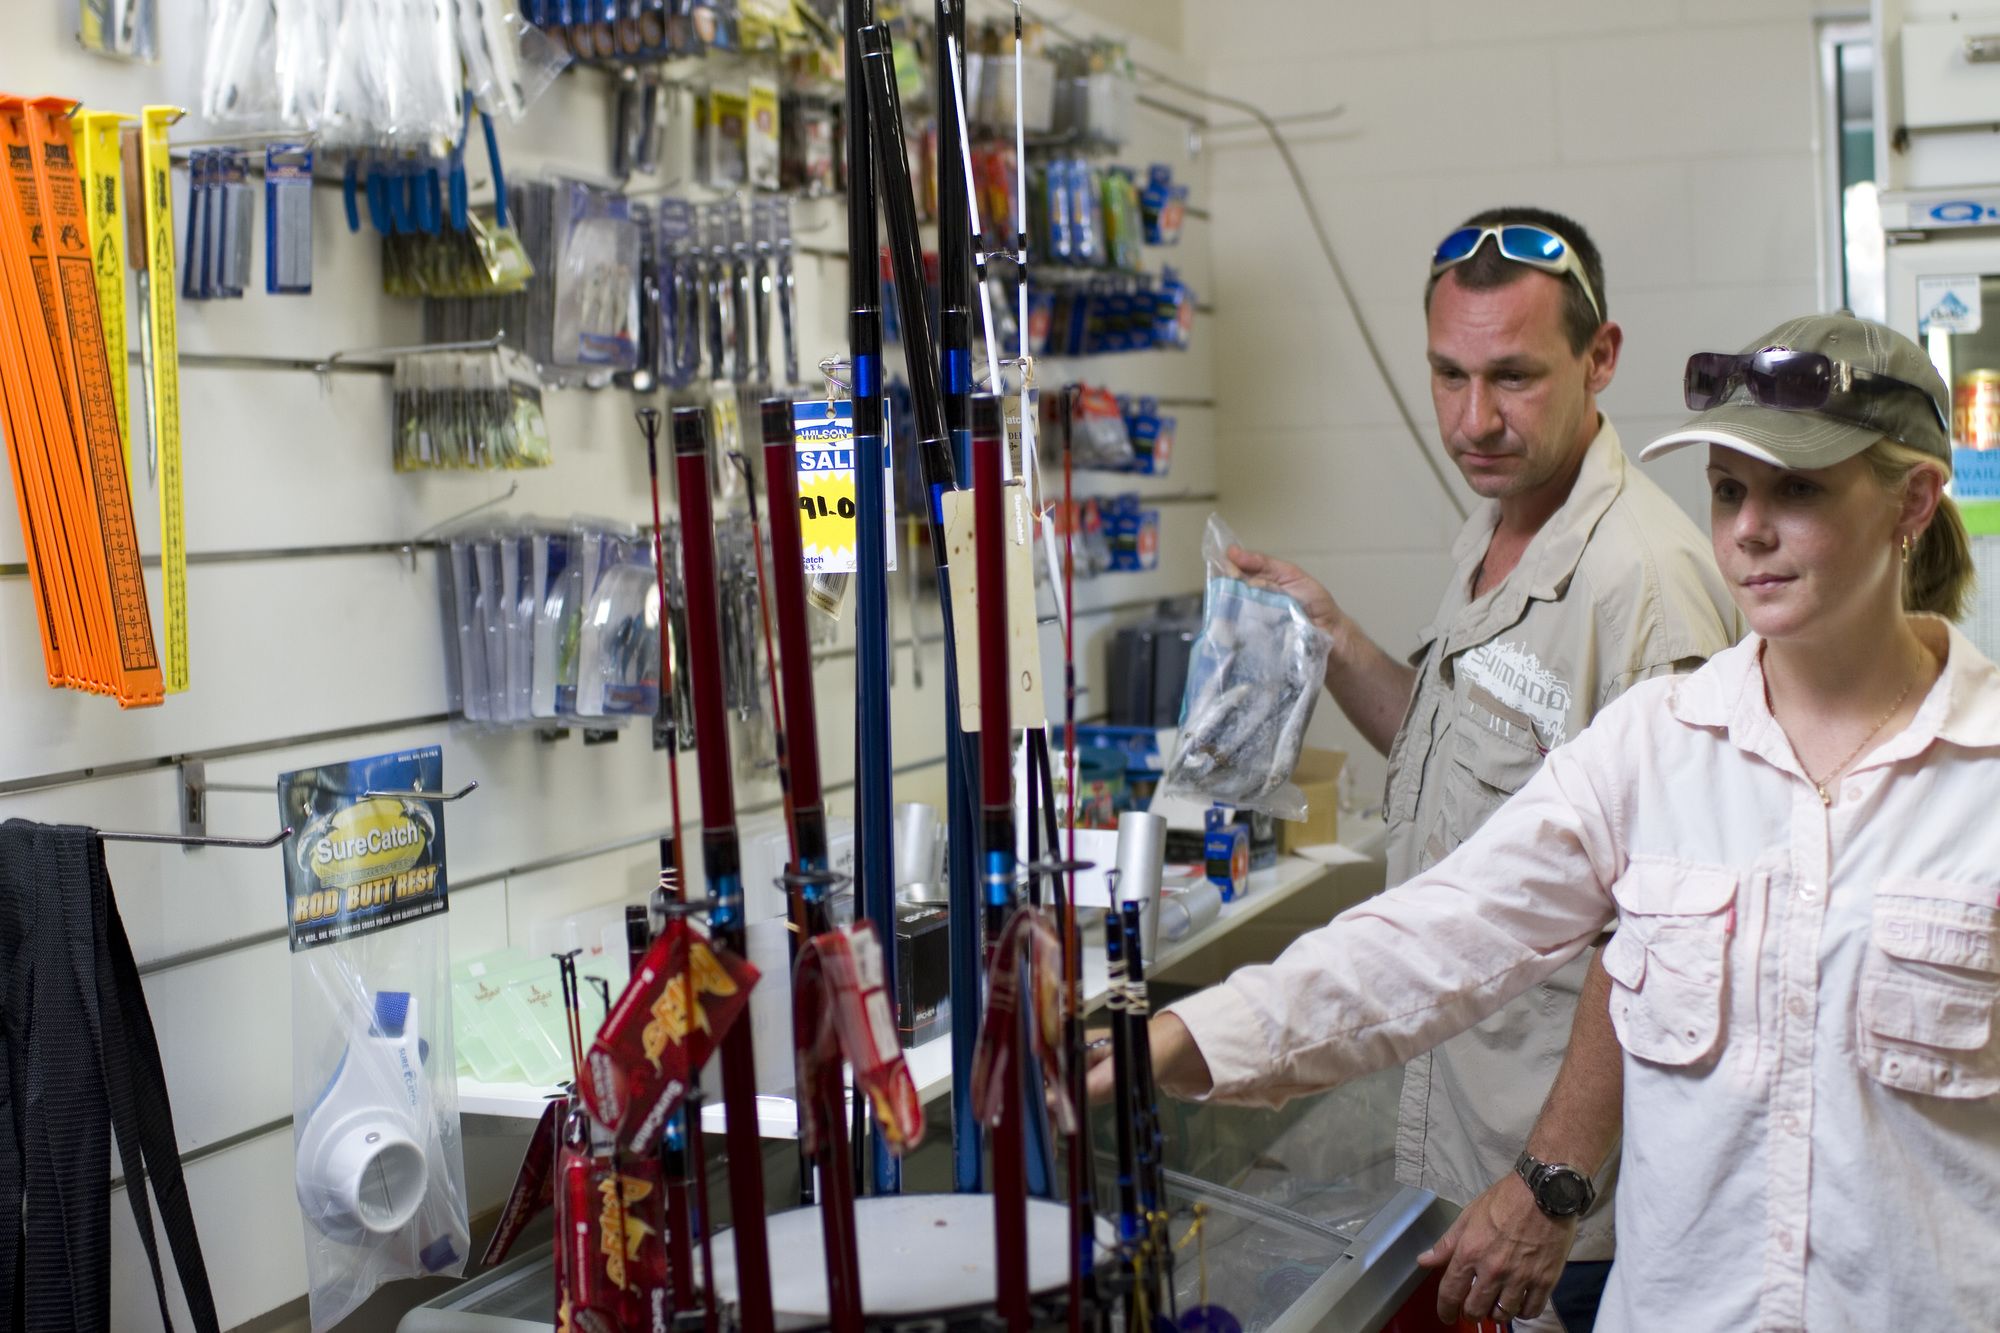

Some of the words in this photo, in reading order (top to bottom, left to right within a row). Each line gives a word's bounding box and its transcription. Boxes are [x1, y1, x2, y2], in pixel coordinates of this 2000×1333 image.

[801, 428, 848, 440] WILSON
[1471, 645, 1566, 711] SHIMANO
[316, 820, 419, 864] SureCatch
[294, 889, 339, 922] ROD
[347, 877, 394, 911] BUTT
[396, 865, 437, 898] REST
